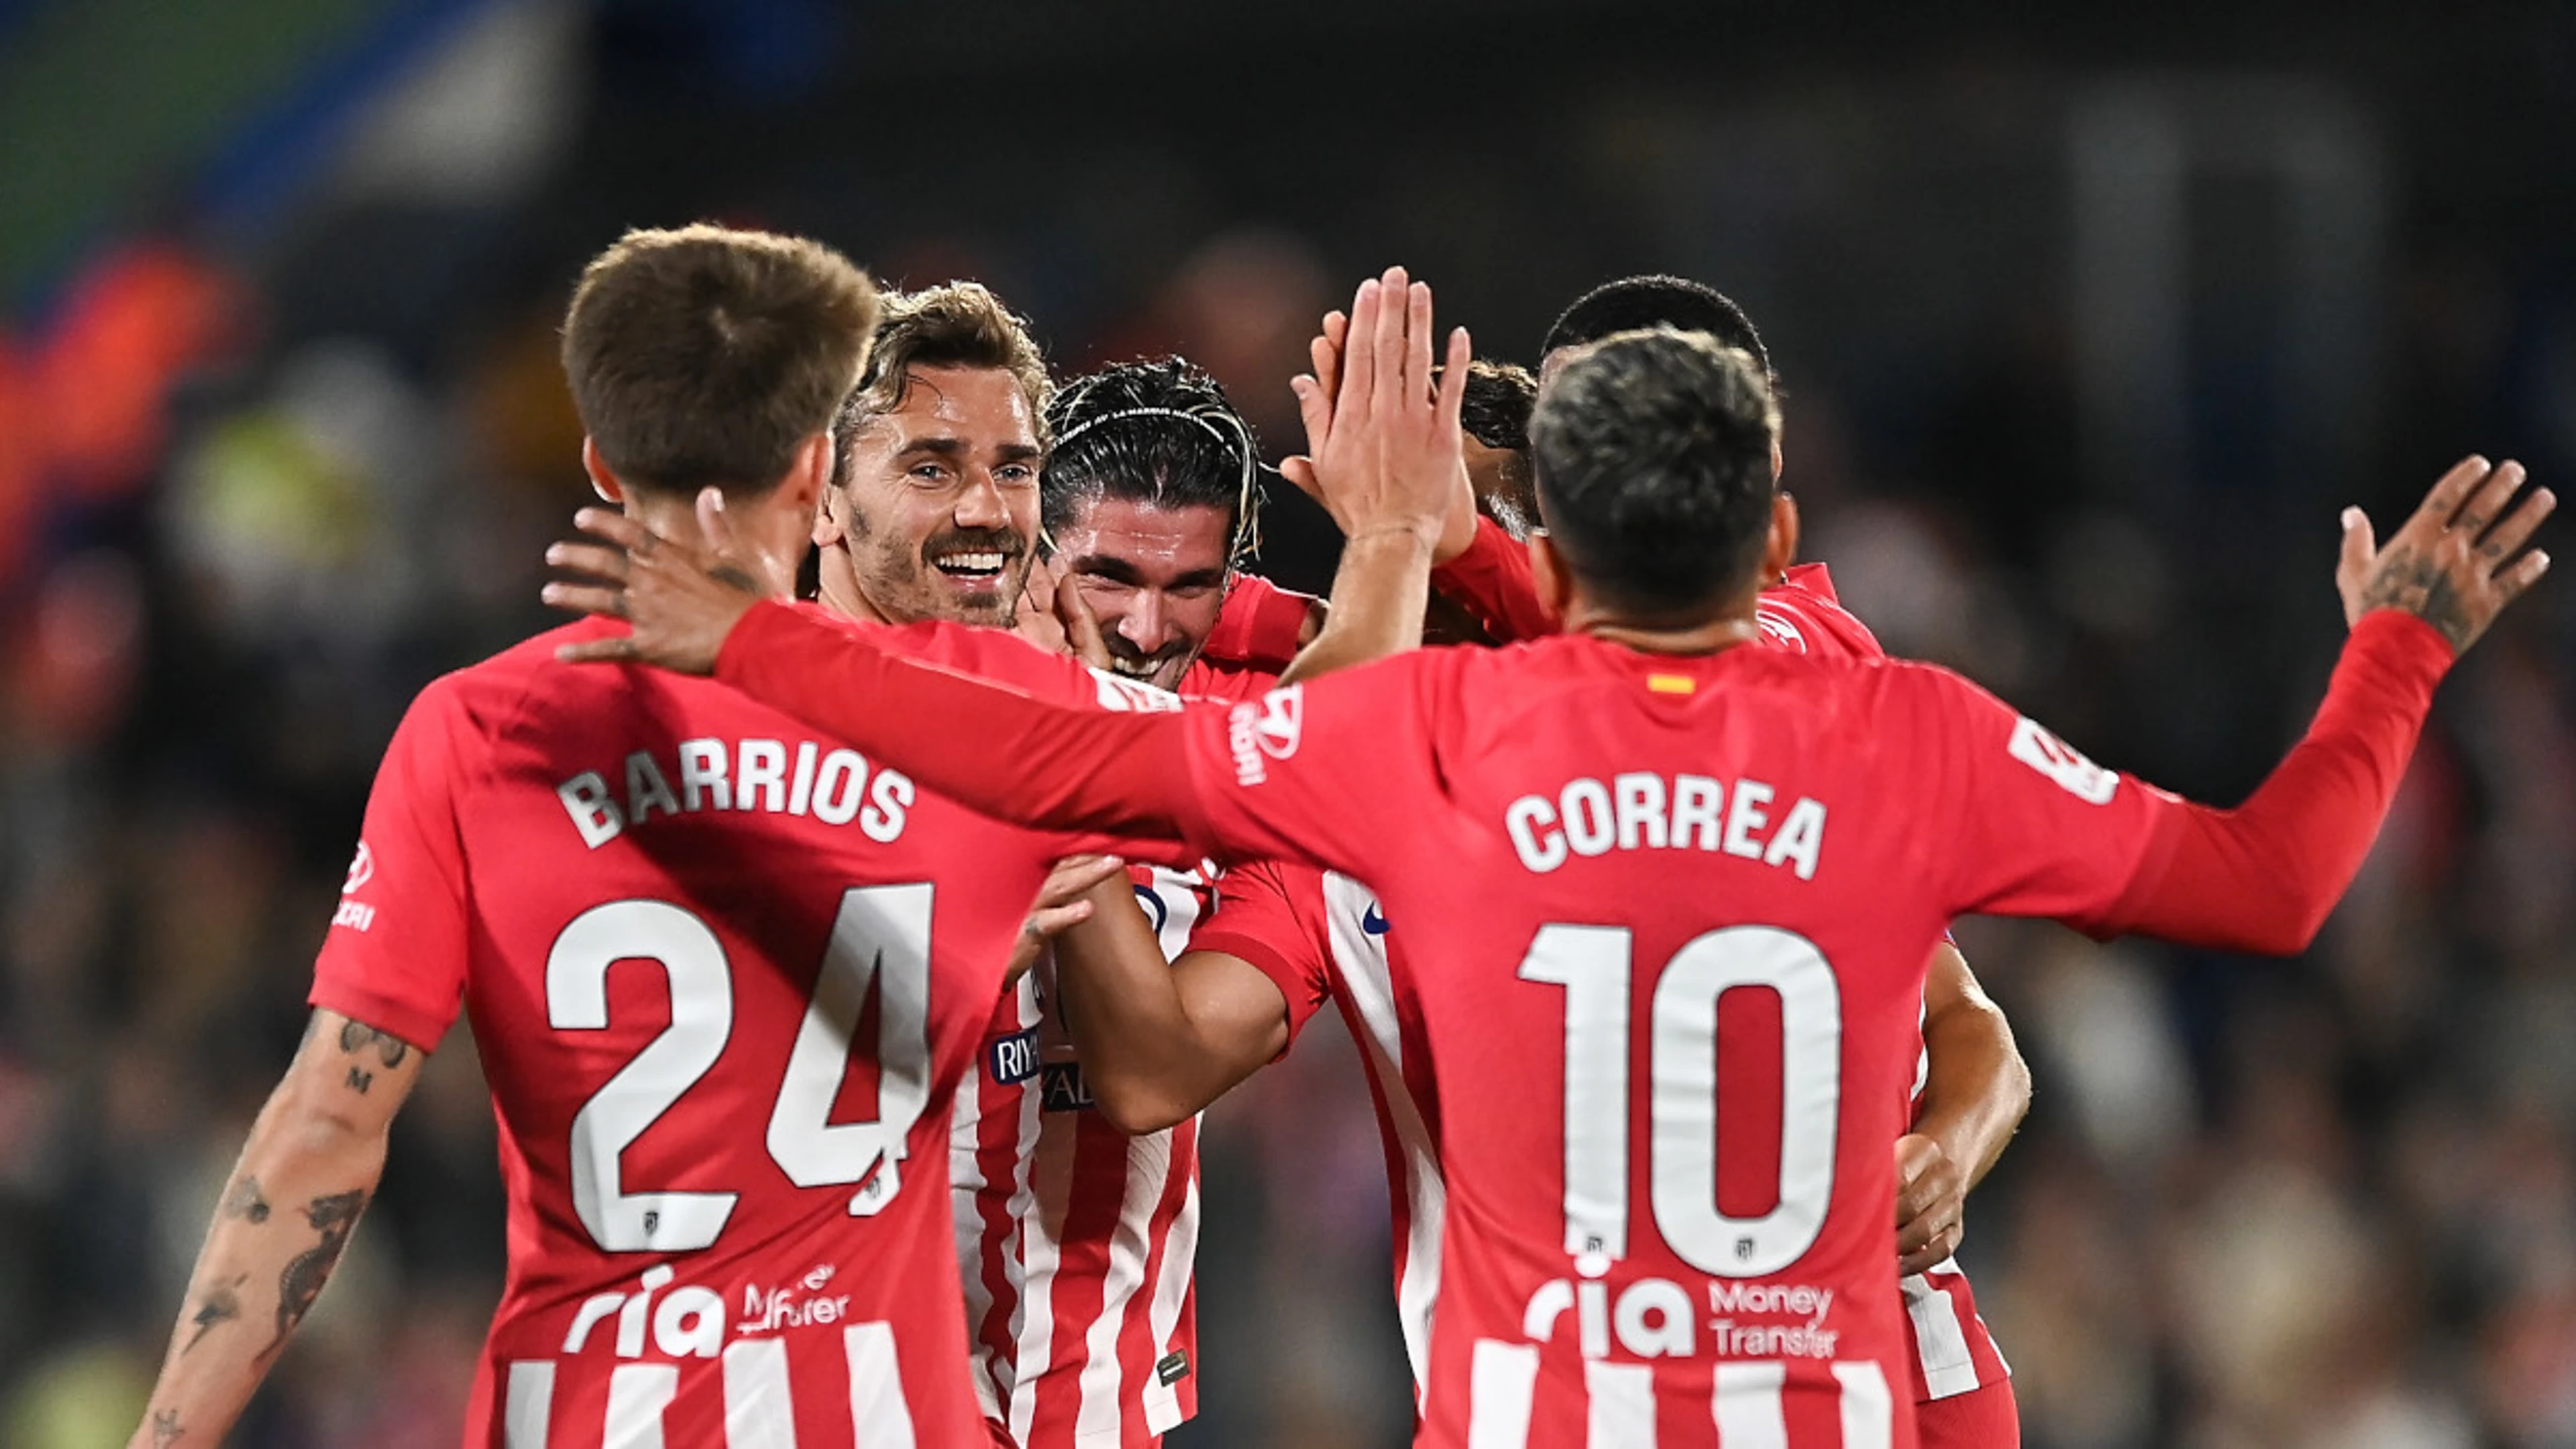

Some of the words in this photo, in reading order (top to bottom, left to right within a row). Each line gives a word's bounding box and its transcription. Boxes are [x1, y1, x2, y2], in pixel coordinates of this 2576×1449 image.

[557, 737, 915, 850] BARRIOS
[1505, 770, 1827, 881] CORREA
[545, 881, 934, 1252] 24
[1516, 922, 1842, 1279] 10
[562, 1263, 727, 1358] ria
[1523, 1253, 1695, 1358] ria
[1707, 1280, 1835, 1323] Money
[1707, 1318, 1839, 1358] Transfer
